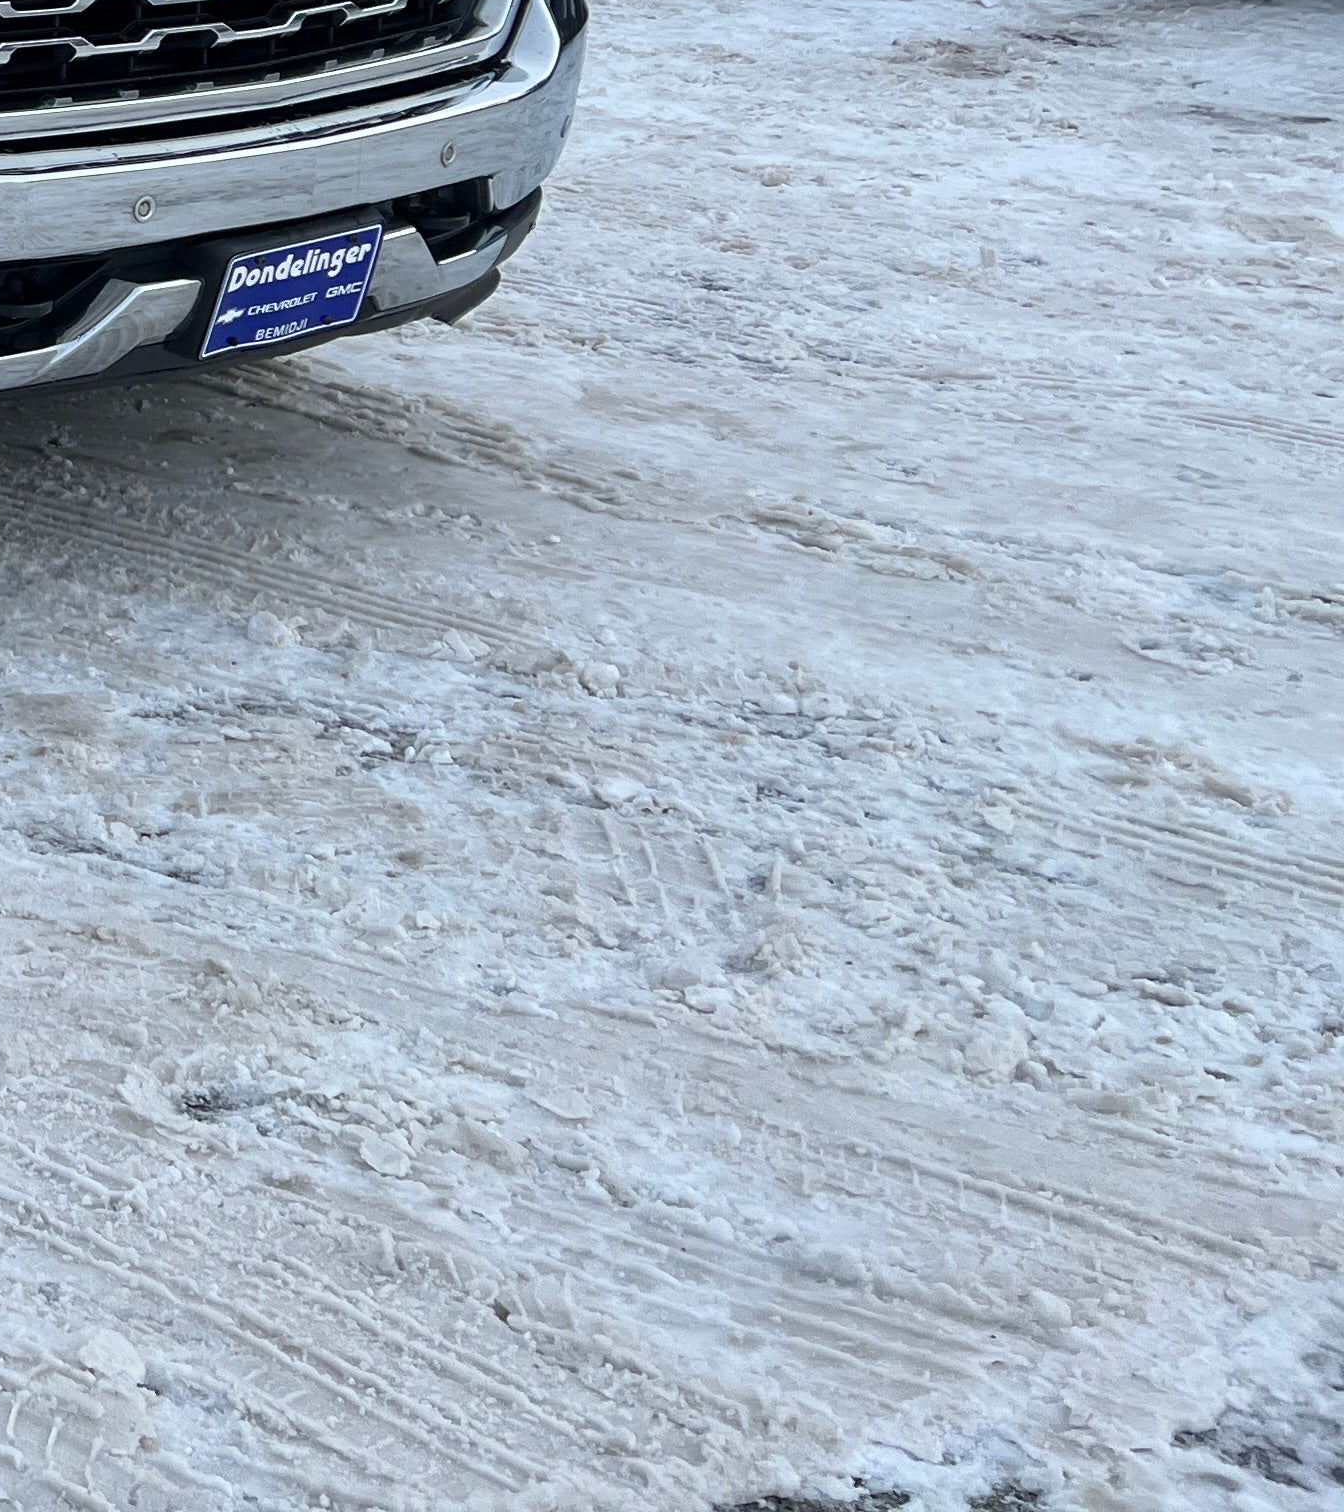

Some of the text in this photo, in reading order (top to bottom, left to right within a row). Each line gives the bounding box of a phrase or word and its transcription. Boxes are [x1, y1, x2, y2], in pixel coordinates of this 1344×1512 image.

[227, 243, 372, 293] Dondelinger
[247, 281, 364, 316] CHEVROLET GMC
[255, 318, 308, 341] BEMIDJI
